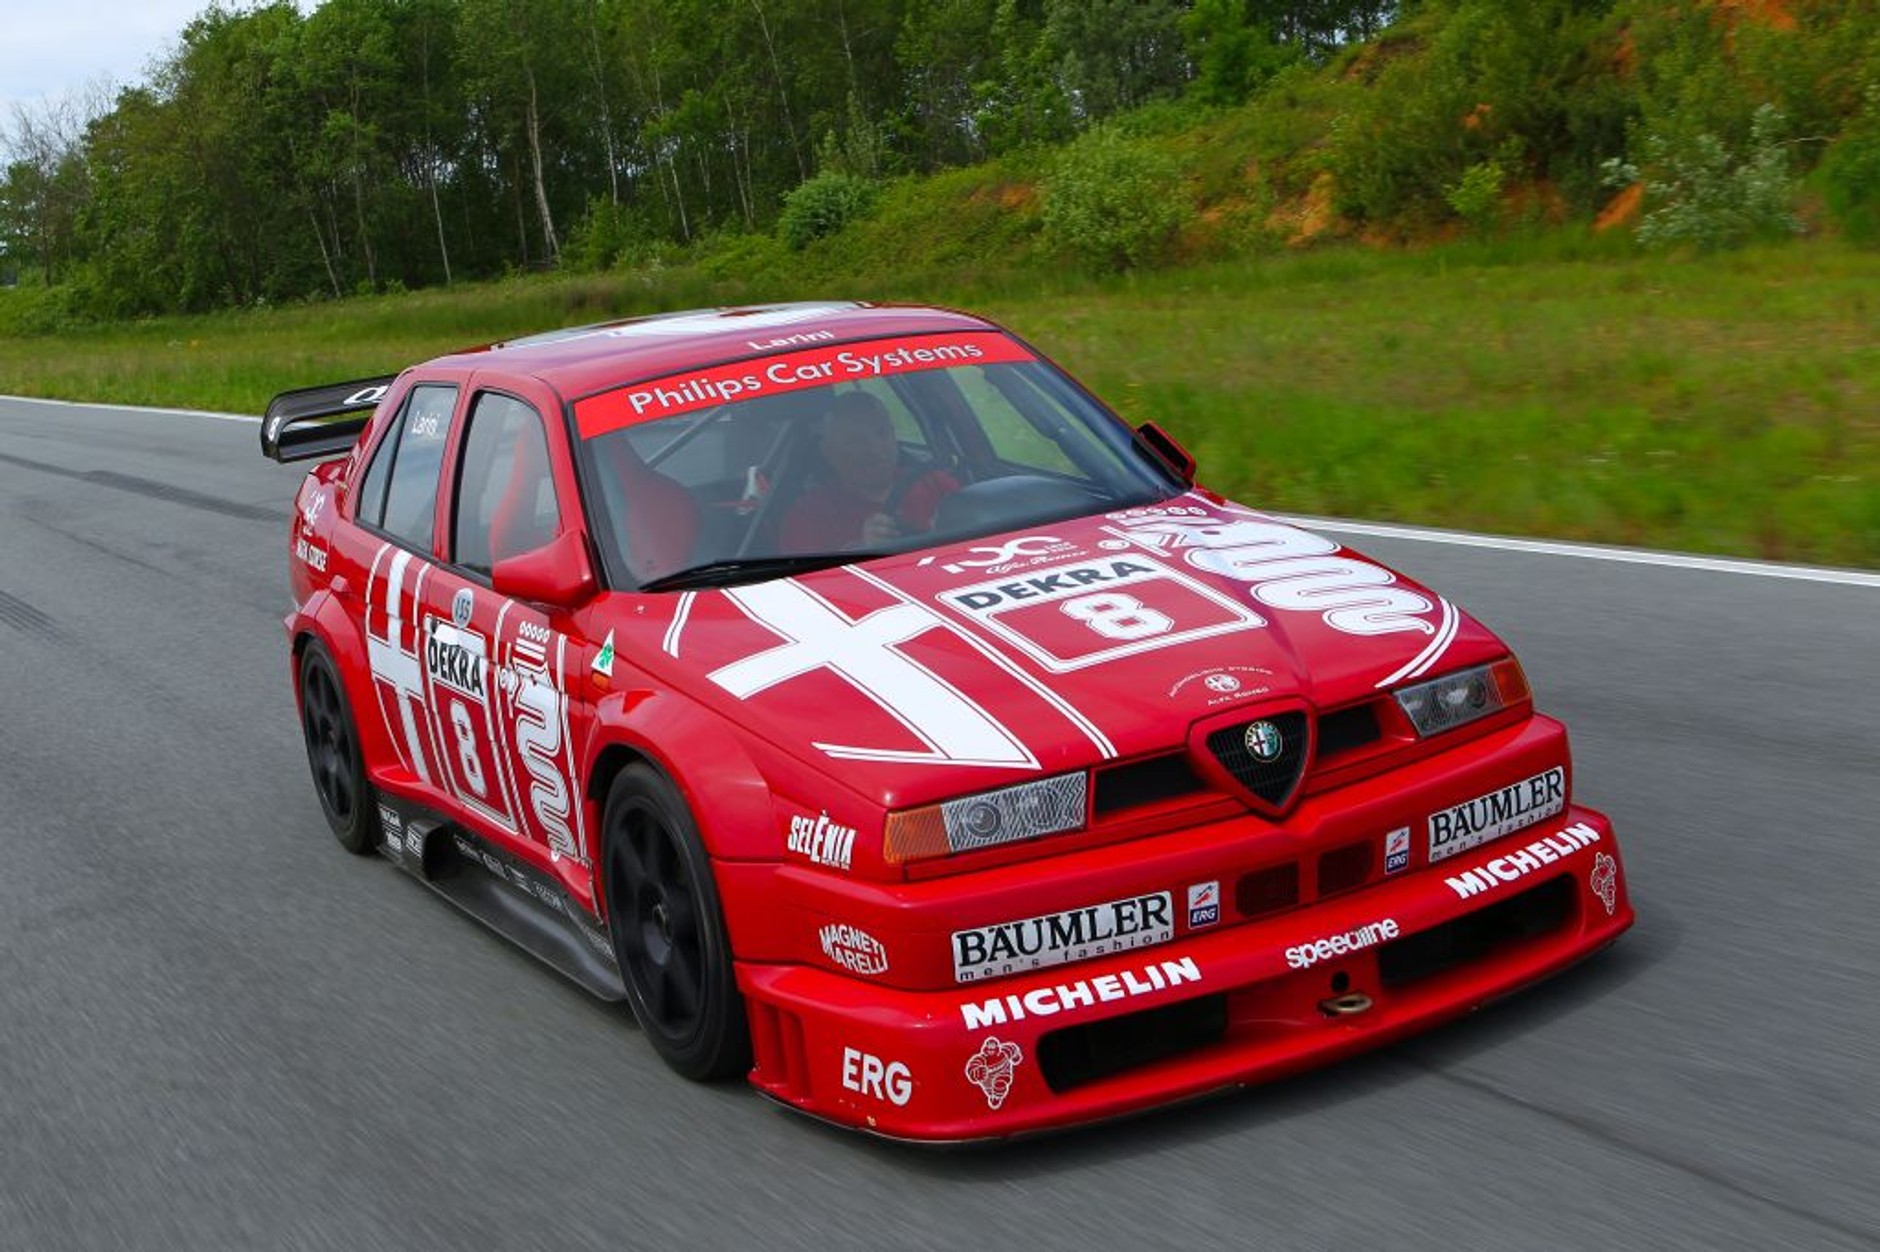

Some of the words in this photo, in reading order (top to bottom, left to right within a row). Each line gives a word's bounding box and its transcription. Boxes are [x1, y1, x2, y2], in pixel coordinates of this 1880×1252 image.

[748, 330, 835, 350] Larini
[628, 371, 762, 415] Philips
[766, 359, 833, 385] Car
[837, 341, 984, 377] Systems
[954, 560, 1155, 611] DEKRA
[1060, 592, 1175, 640] 8
[428, 635, 485, 698] DEKRA
[451, 698, 487, 798] 8
[1430, 769, 1563, 848] BÄUMLER
[1387, 852, 1407, 869] ERG
[1443, 822, 1601, 899] MICHELIN
[956, 894, 1170, 967] BÄUMLER
[1191, 906, 1216, 924] ERG
[959, 958, 1040, 982] men's
[1063, 930, 1169, 962] fashion
[960, 956, 1202, 1031] MICHELIN
[841, 1046, 912, 1107] ERG
